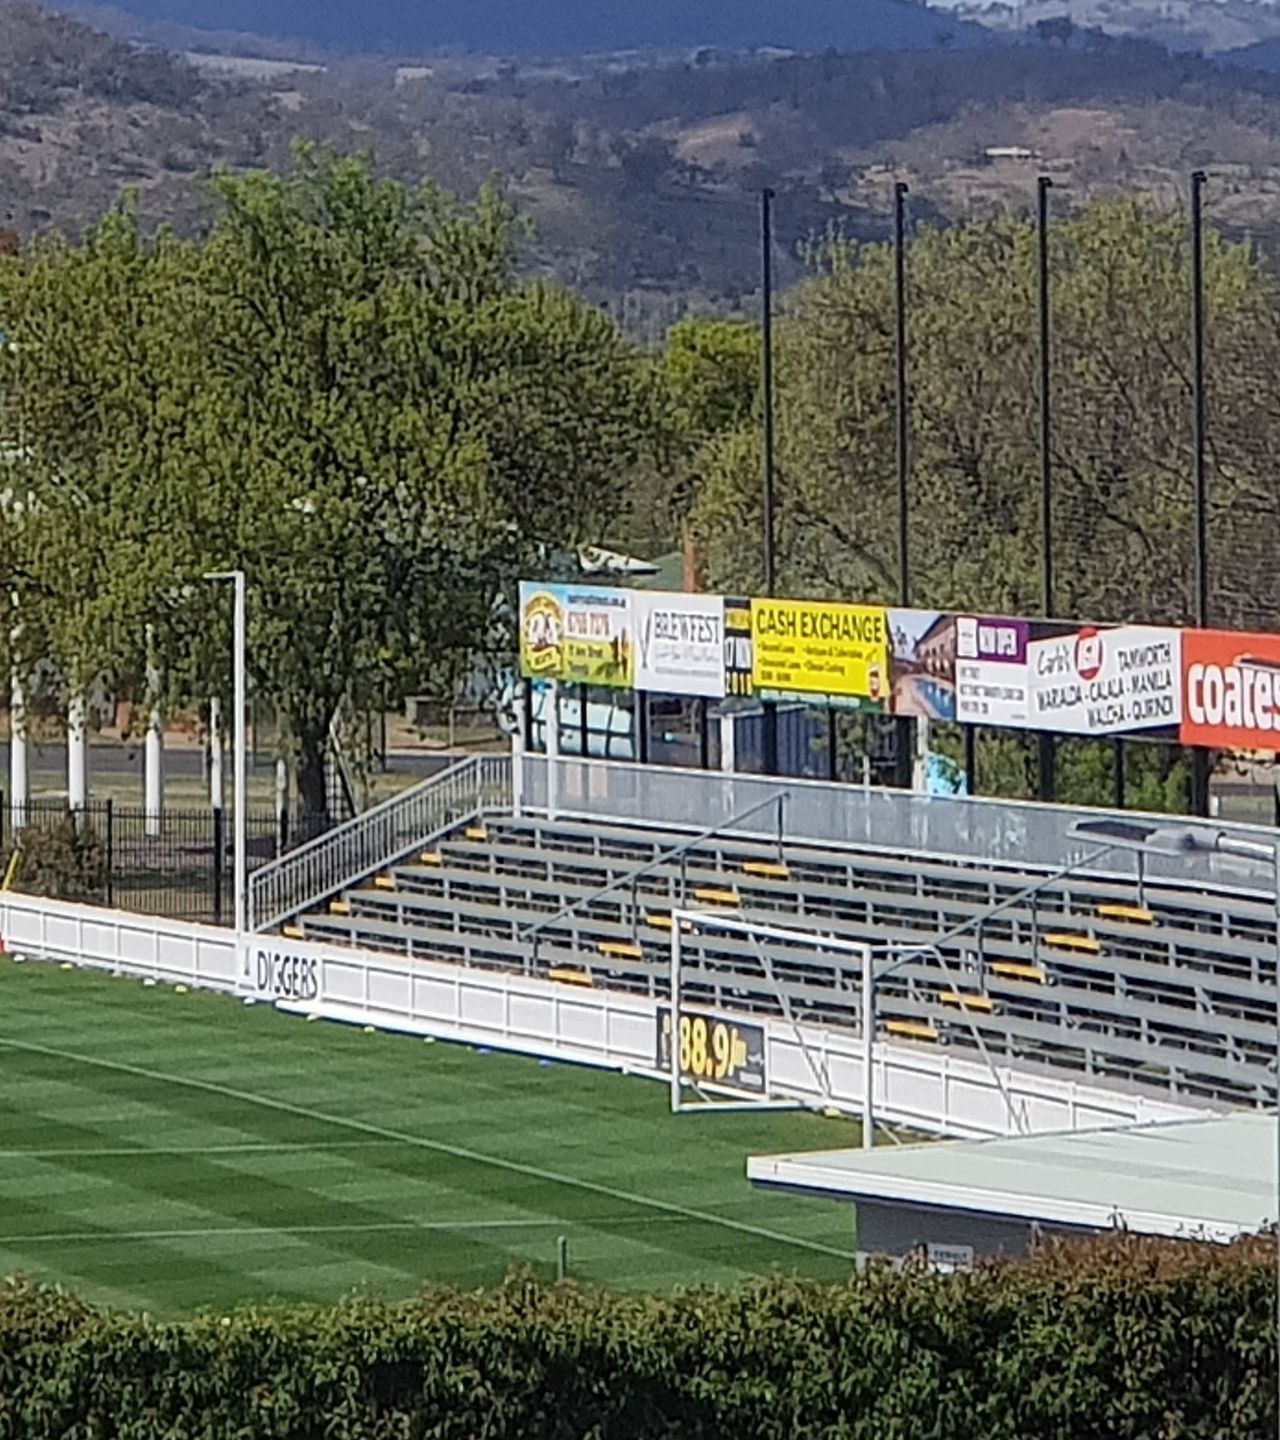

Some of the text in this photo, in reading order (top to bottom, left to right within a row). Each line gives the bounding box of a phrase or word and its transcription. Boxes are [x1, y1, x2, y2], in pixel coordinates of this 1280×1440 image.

[655, 611, 719, 644] BREWFEST
[756, 608, 796, 638] CASH
[801, 611, 882, 643] EXCHANGE
[1118, 642, 1171, 672] TAMWORTH
[257, 950, 318, 999] DIGGERS
